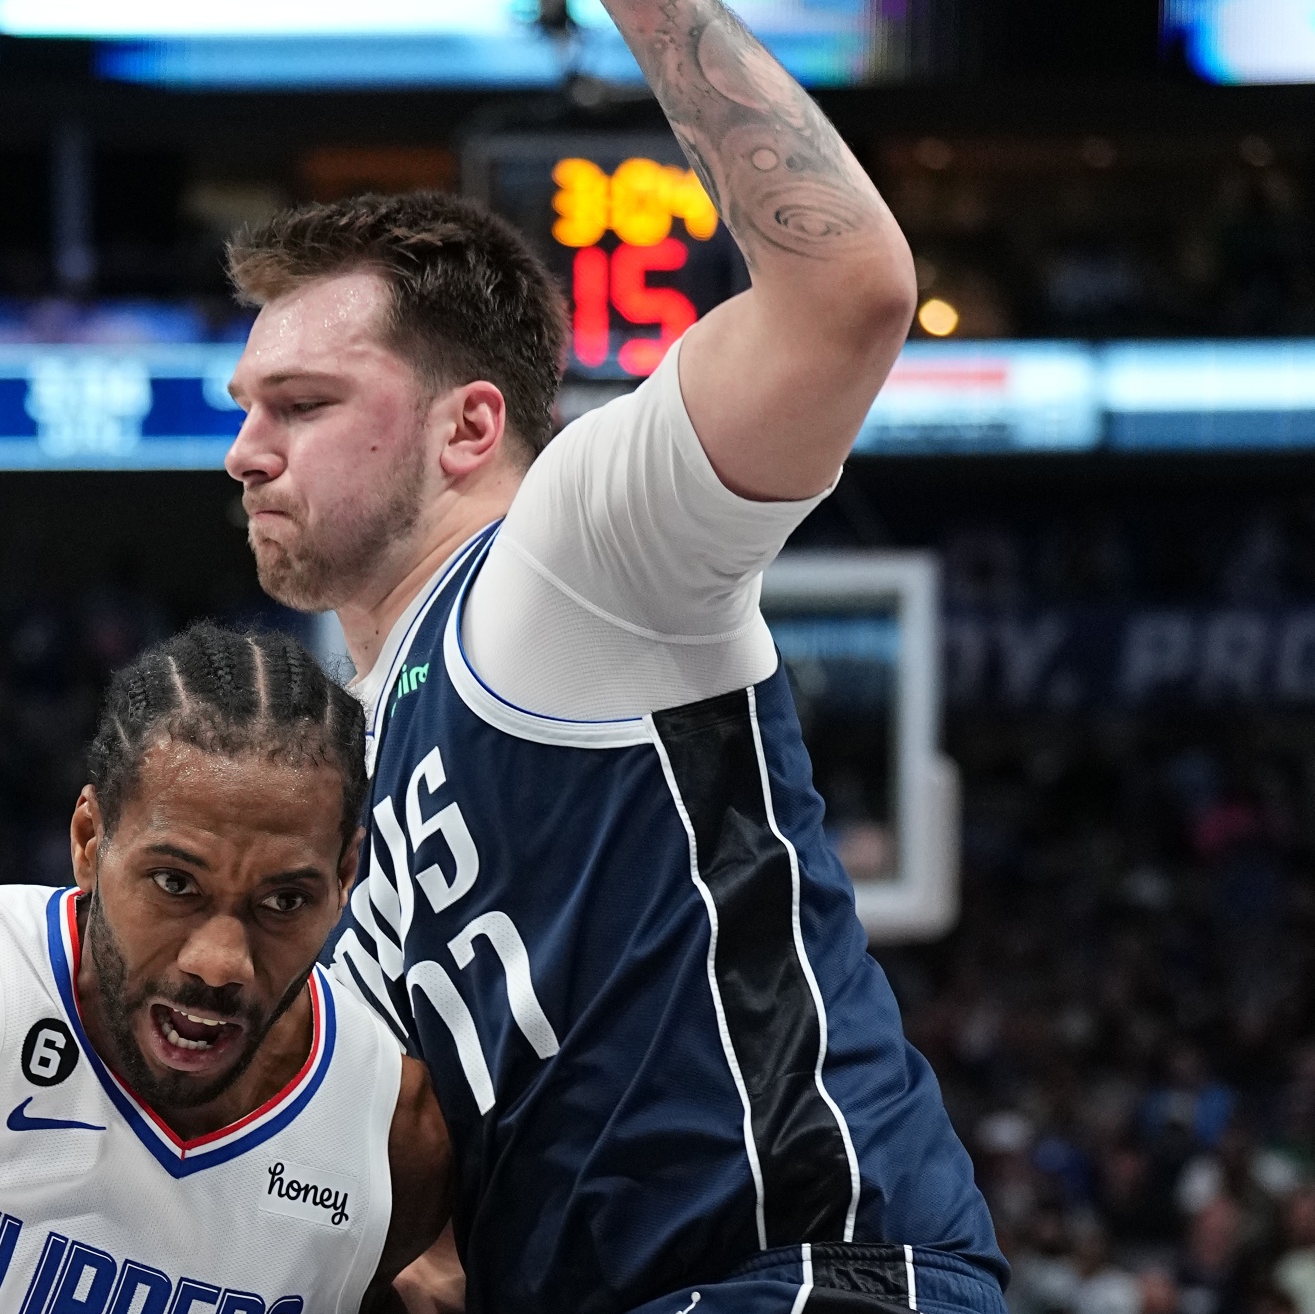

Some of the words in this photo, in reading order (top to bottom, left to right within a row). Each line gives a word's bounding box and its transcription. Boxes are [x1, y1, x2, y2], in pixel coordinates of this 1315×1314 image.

[572, 238, 698, 377] 15
[29, 1028, 67, 1079] 6
[406, 911, 561, 1116] 77
[267, 1161, 350, 1226] honey
